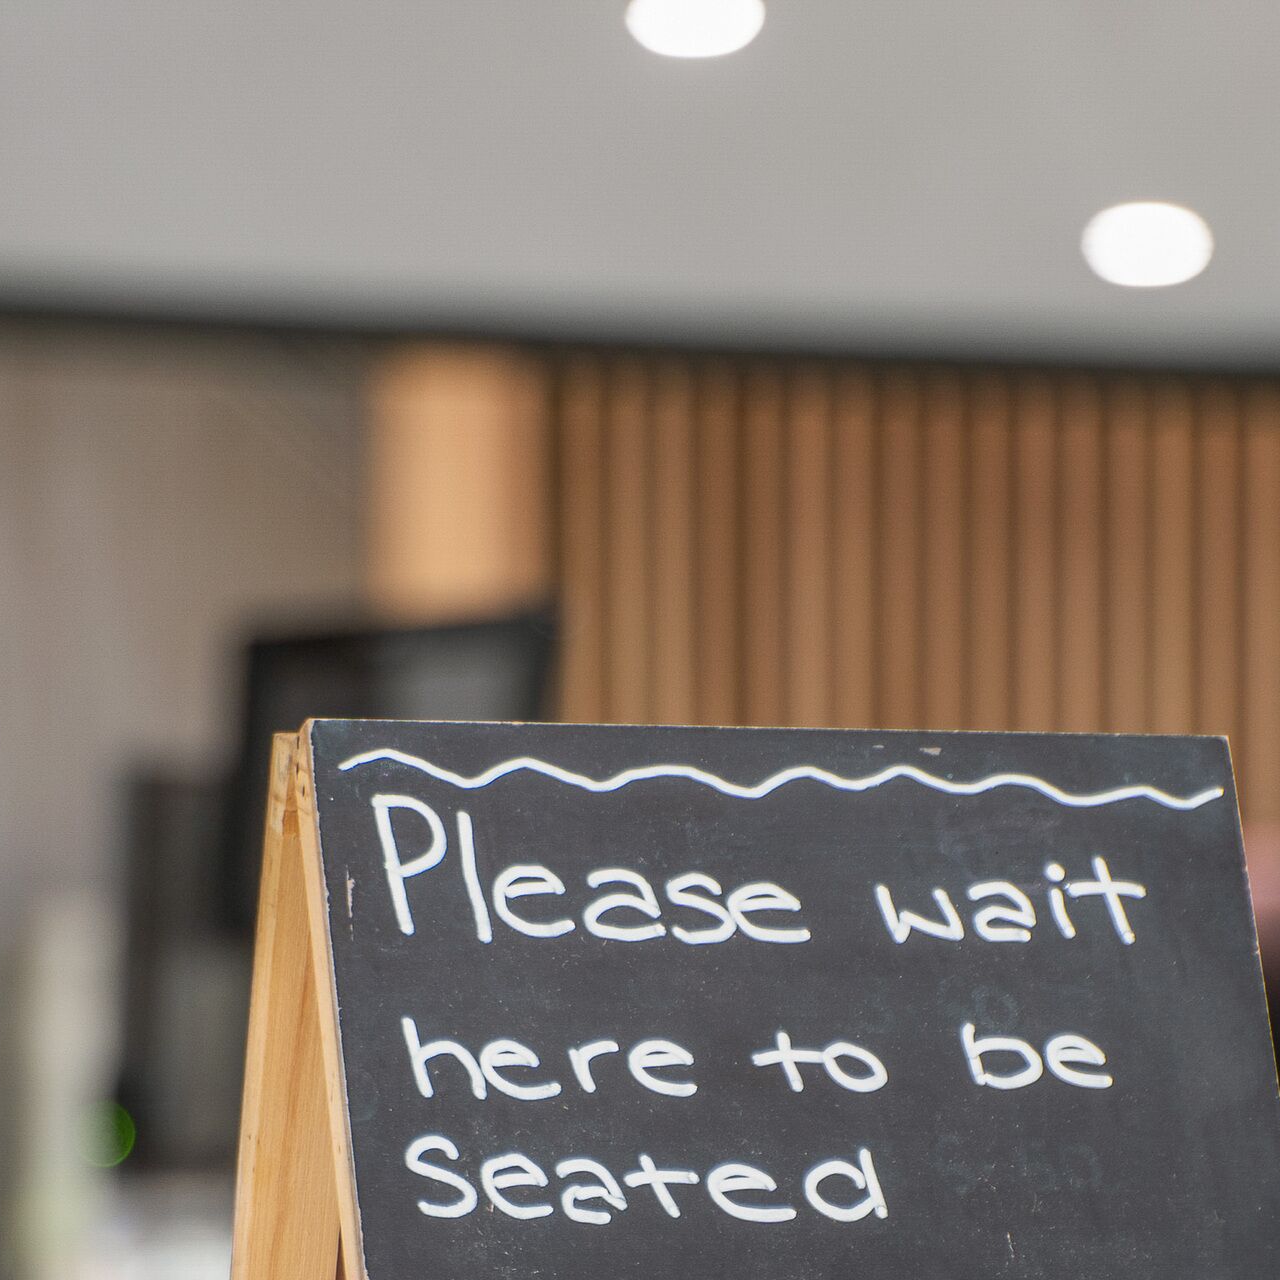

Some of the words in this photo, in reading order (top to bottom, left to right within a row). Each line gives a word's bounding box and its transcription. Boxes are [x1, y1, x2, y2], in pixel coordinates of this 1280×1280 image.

[370, 793, 812, 946] Please
[873, 855, 1147, 946] wait
[401, 1015, 699, 1101] here
[751, 1029, 889, 1093] to
[960, 1020, 1114, 1090] be
